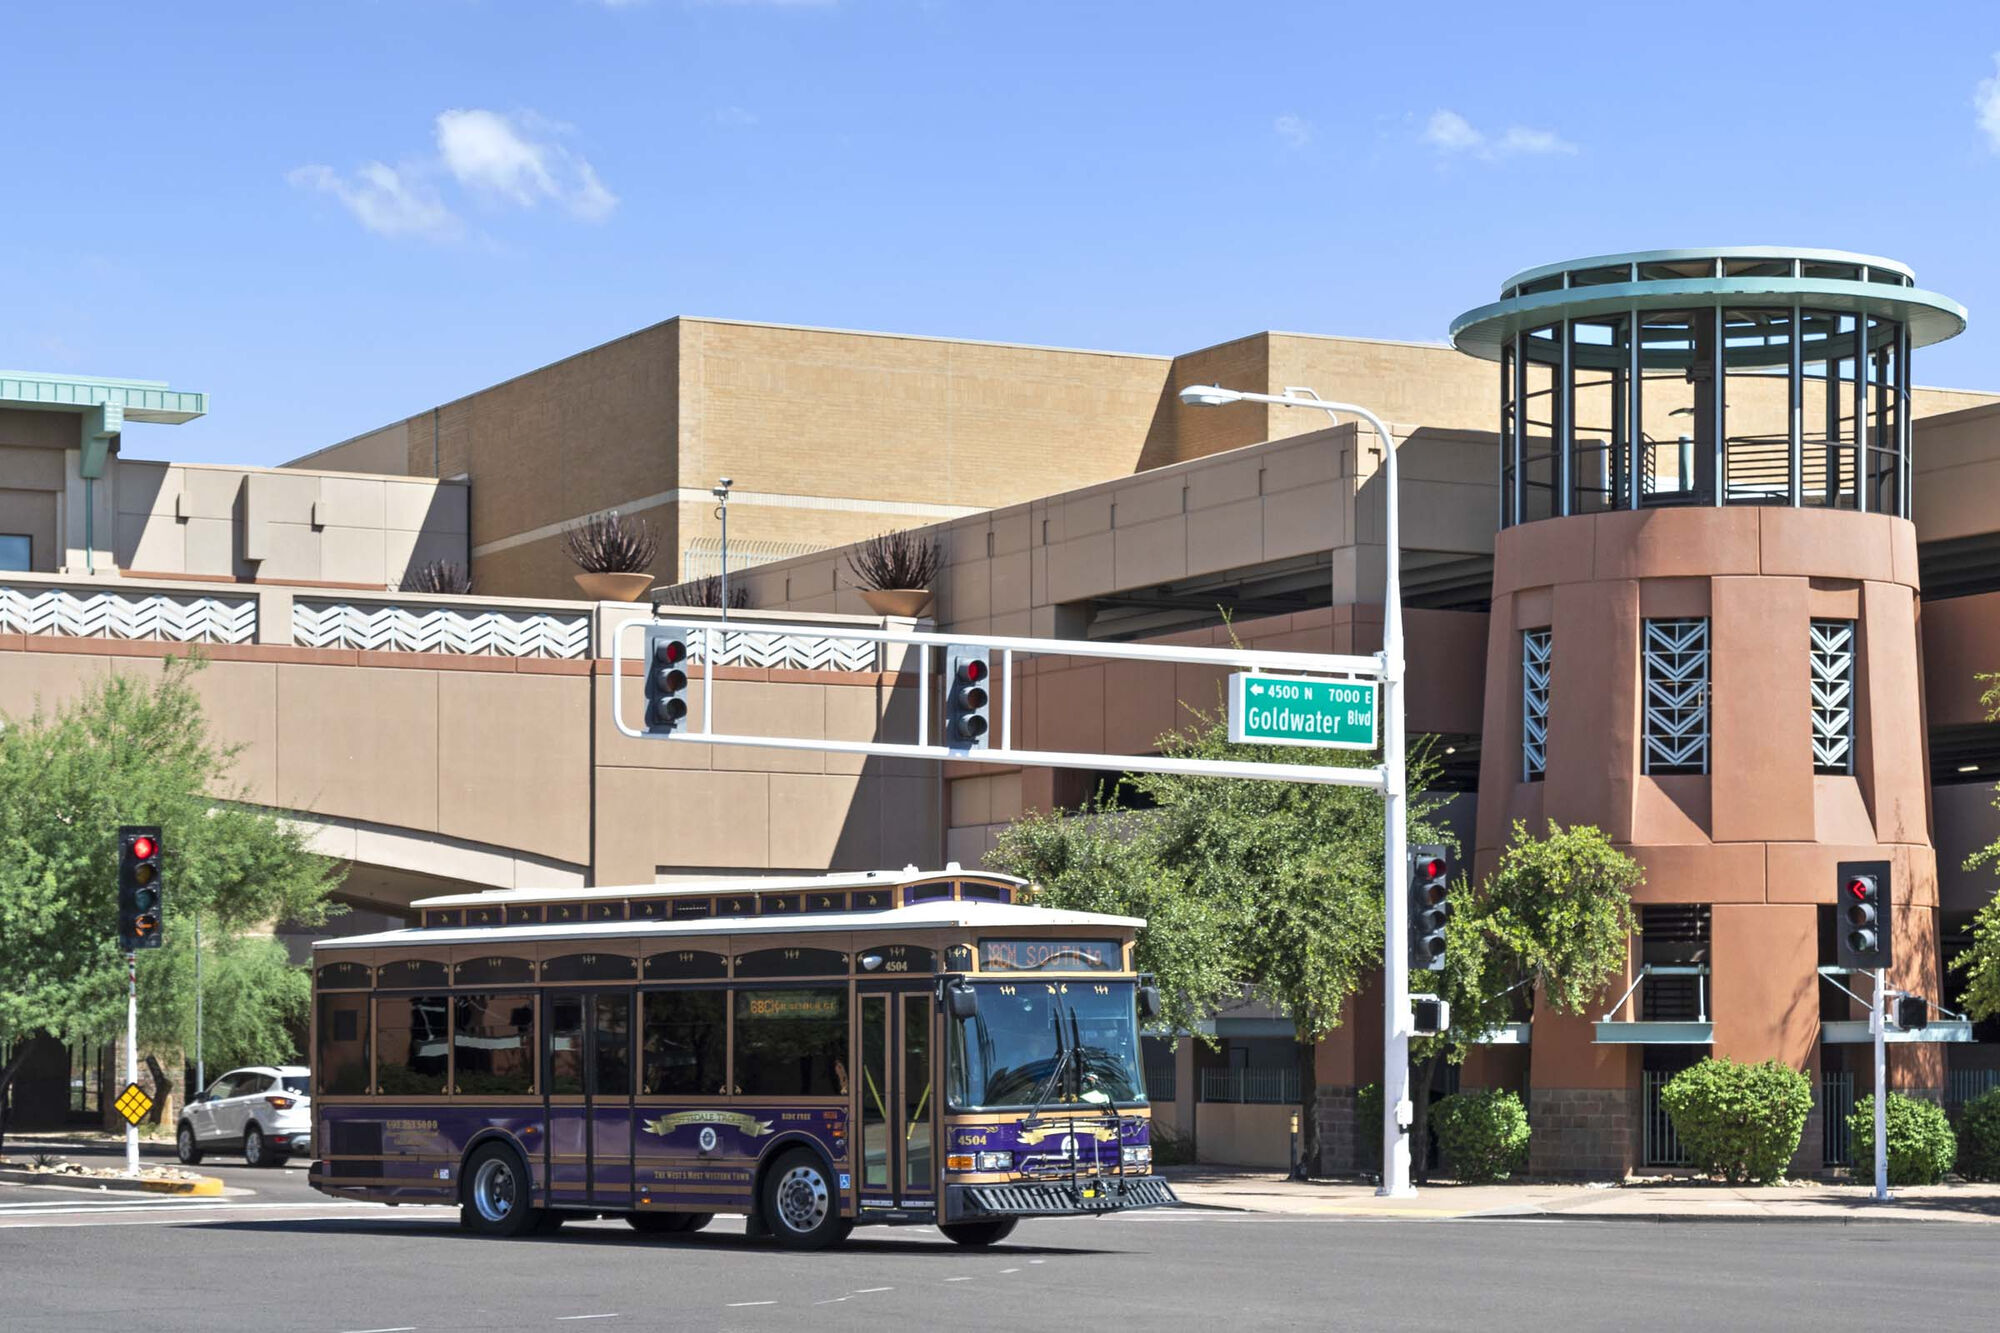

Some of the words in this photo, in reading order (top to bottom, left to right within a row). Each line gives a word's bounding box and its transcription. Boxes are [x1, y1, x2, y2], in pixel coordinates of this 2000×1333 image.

[1268, 685, 1299, 700] 4500
[1304, 687, 1313, 700] N
[1328, 688, 1360, 704] 7000
[1365, 691, 1371, 704] E
[1249, 706, 1341, 734] Goldwater
[1347, 710, 1371, 727] Blvd
[1026, 945, 1080, 967] SOUTH
[885, 961, 908, 972] 4504
[958, 1134, 987, 1146] 4504
